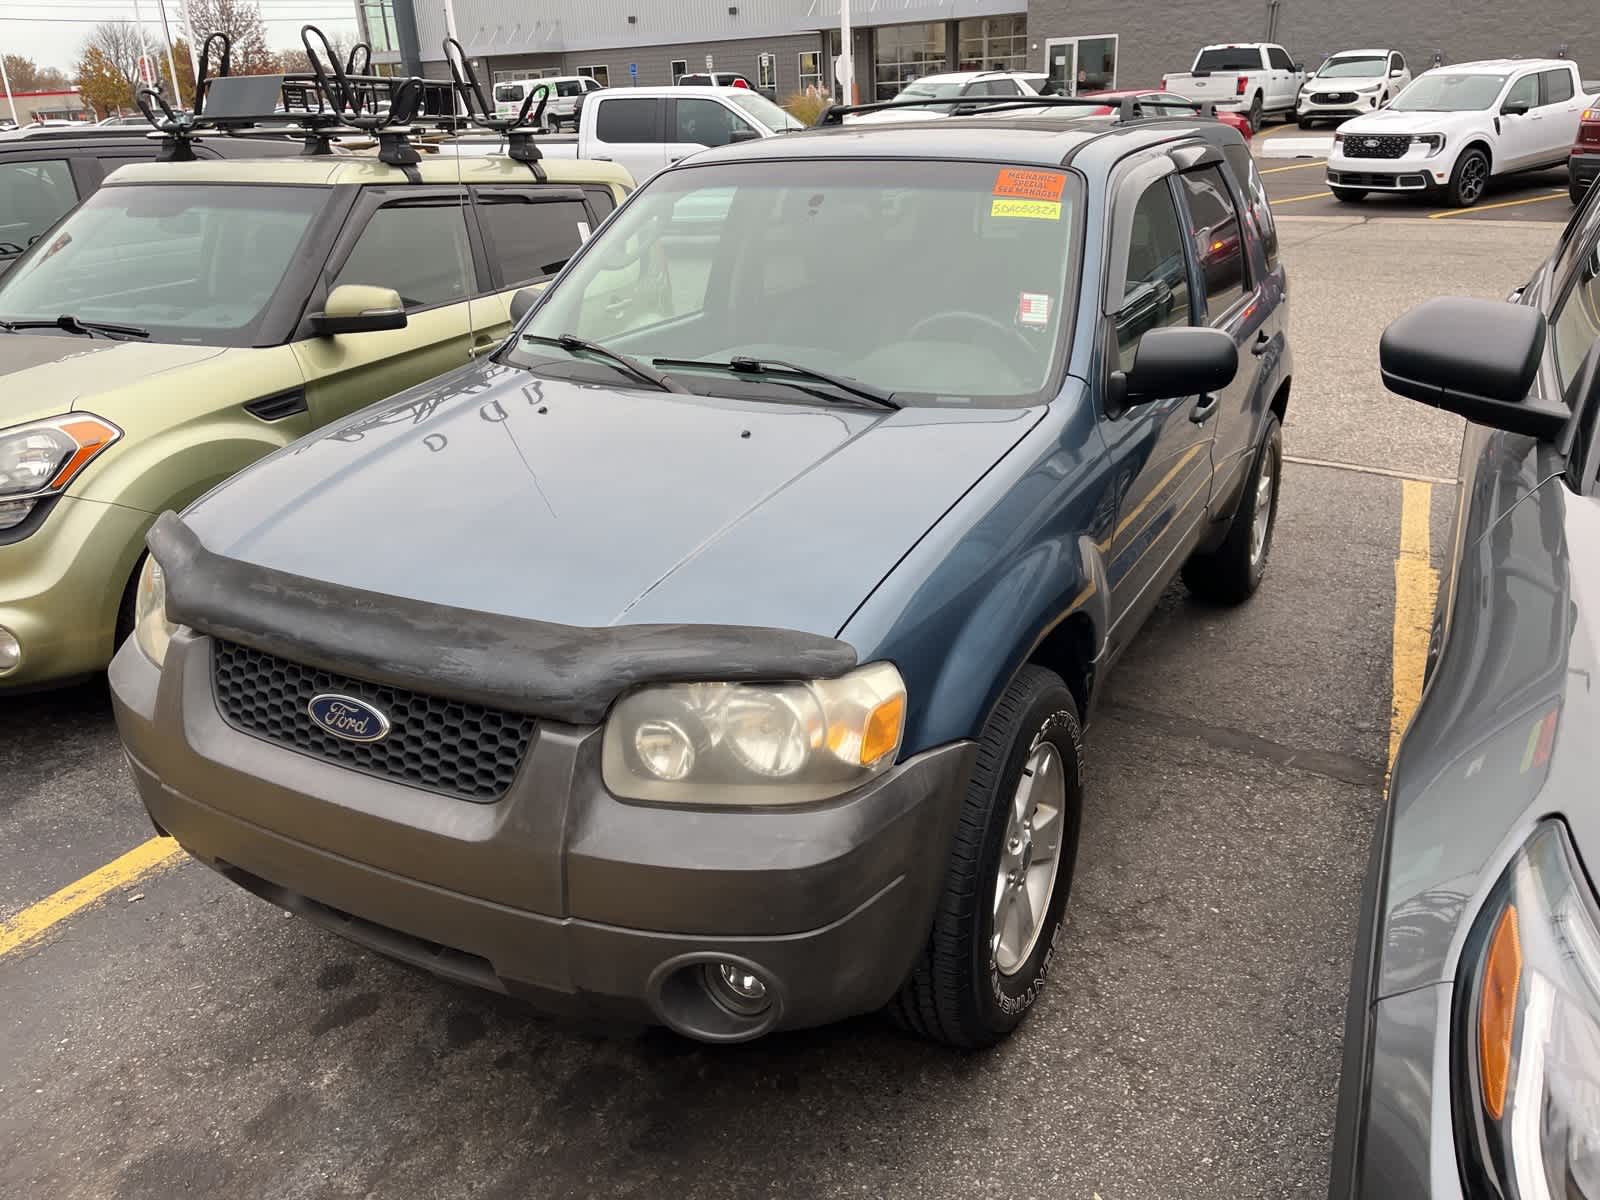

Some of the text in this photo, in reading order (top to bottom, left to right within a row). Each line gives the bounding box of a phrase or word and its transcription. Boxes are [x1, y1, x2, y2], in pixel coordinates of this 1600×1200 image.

[1008, 171, 1057, 183] MECHANICS
[1014, 179, 1048, 189] SPECIAL
[998, 185, 1059, 198] SEE MANAGER
[325, 702, 369, 734] Ford
